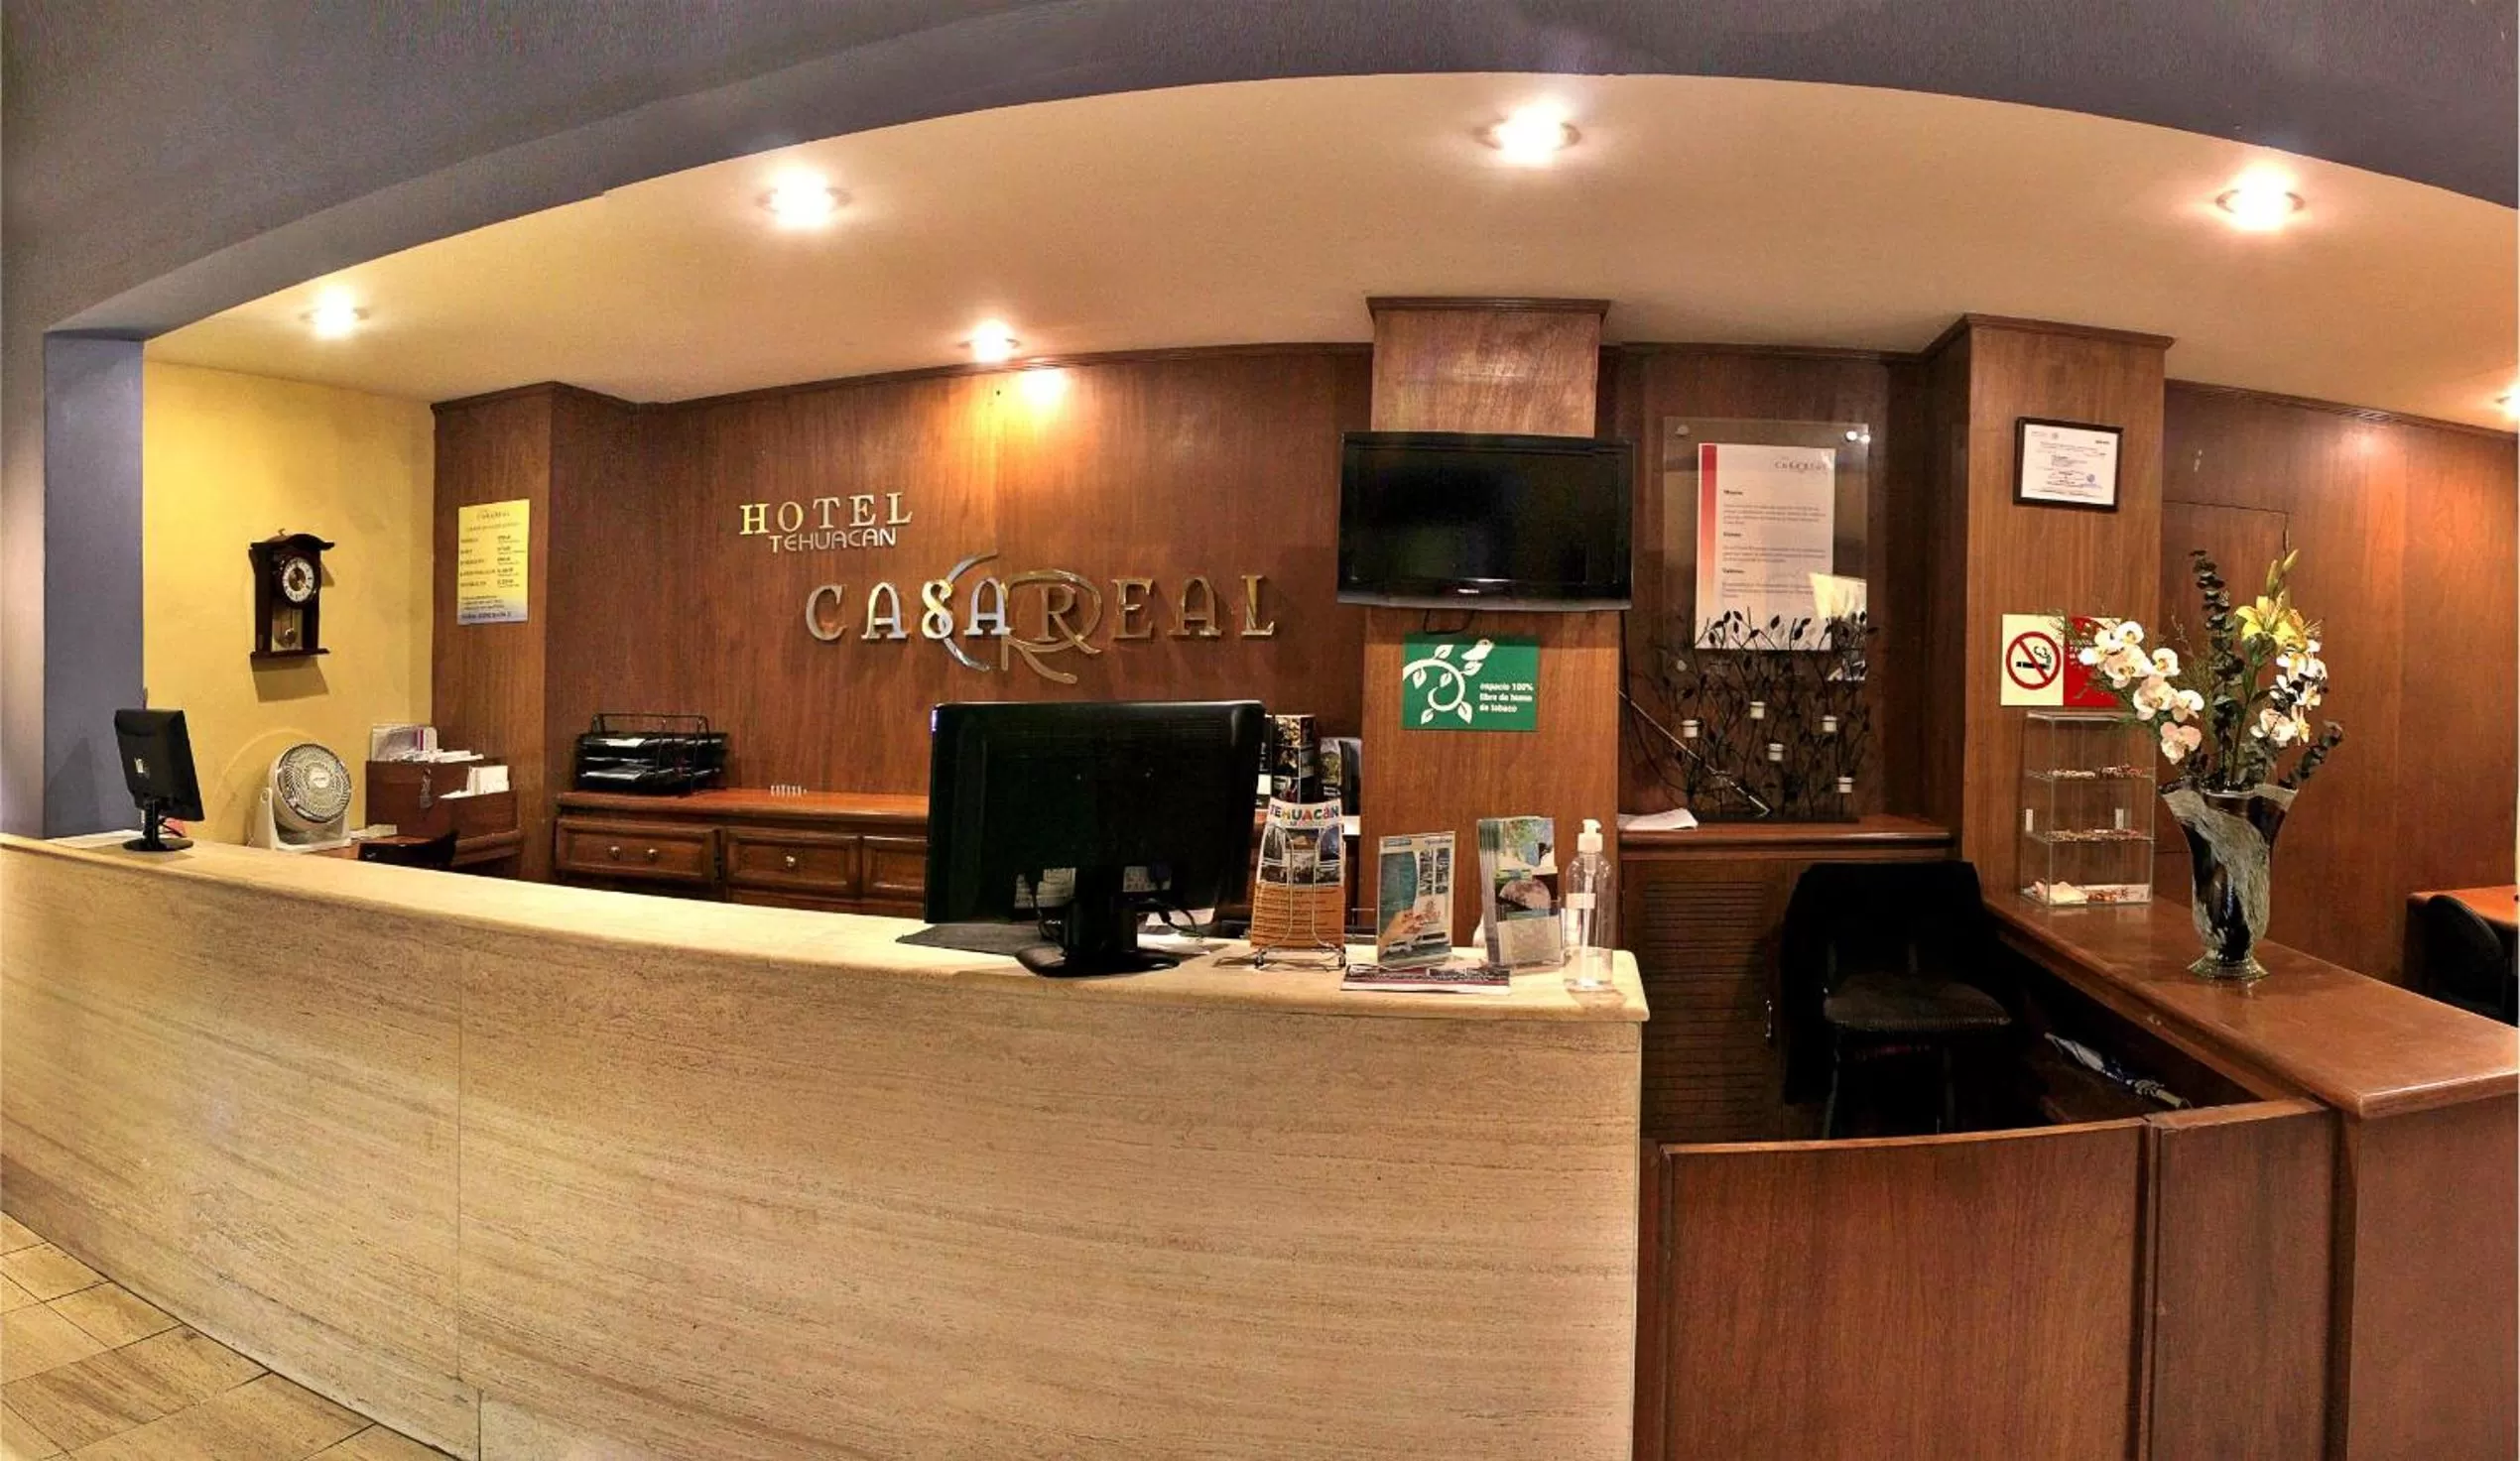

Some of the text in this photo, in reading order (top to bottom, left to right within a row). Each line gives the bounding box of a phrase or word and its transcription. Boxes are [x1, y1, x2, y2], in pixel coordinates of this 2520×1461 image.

[739, 492, 913, 536] HOTEL
[769, 528, 897, 553] TEHUACAN
[805, 574, 1275, 643] CASA REAL
[1511, 681, 1534, 691] 100%
